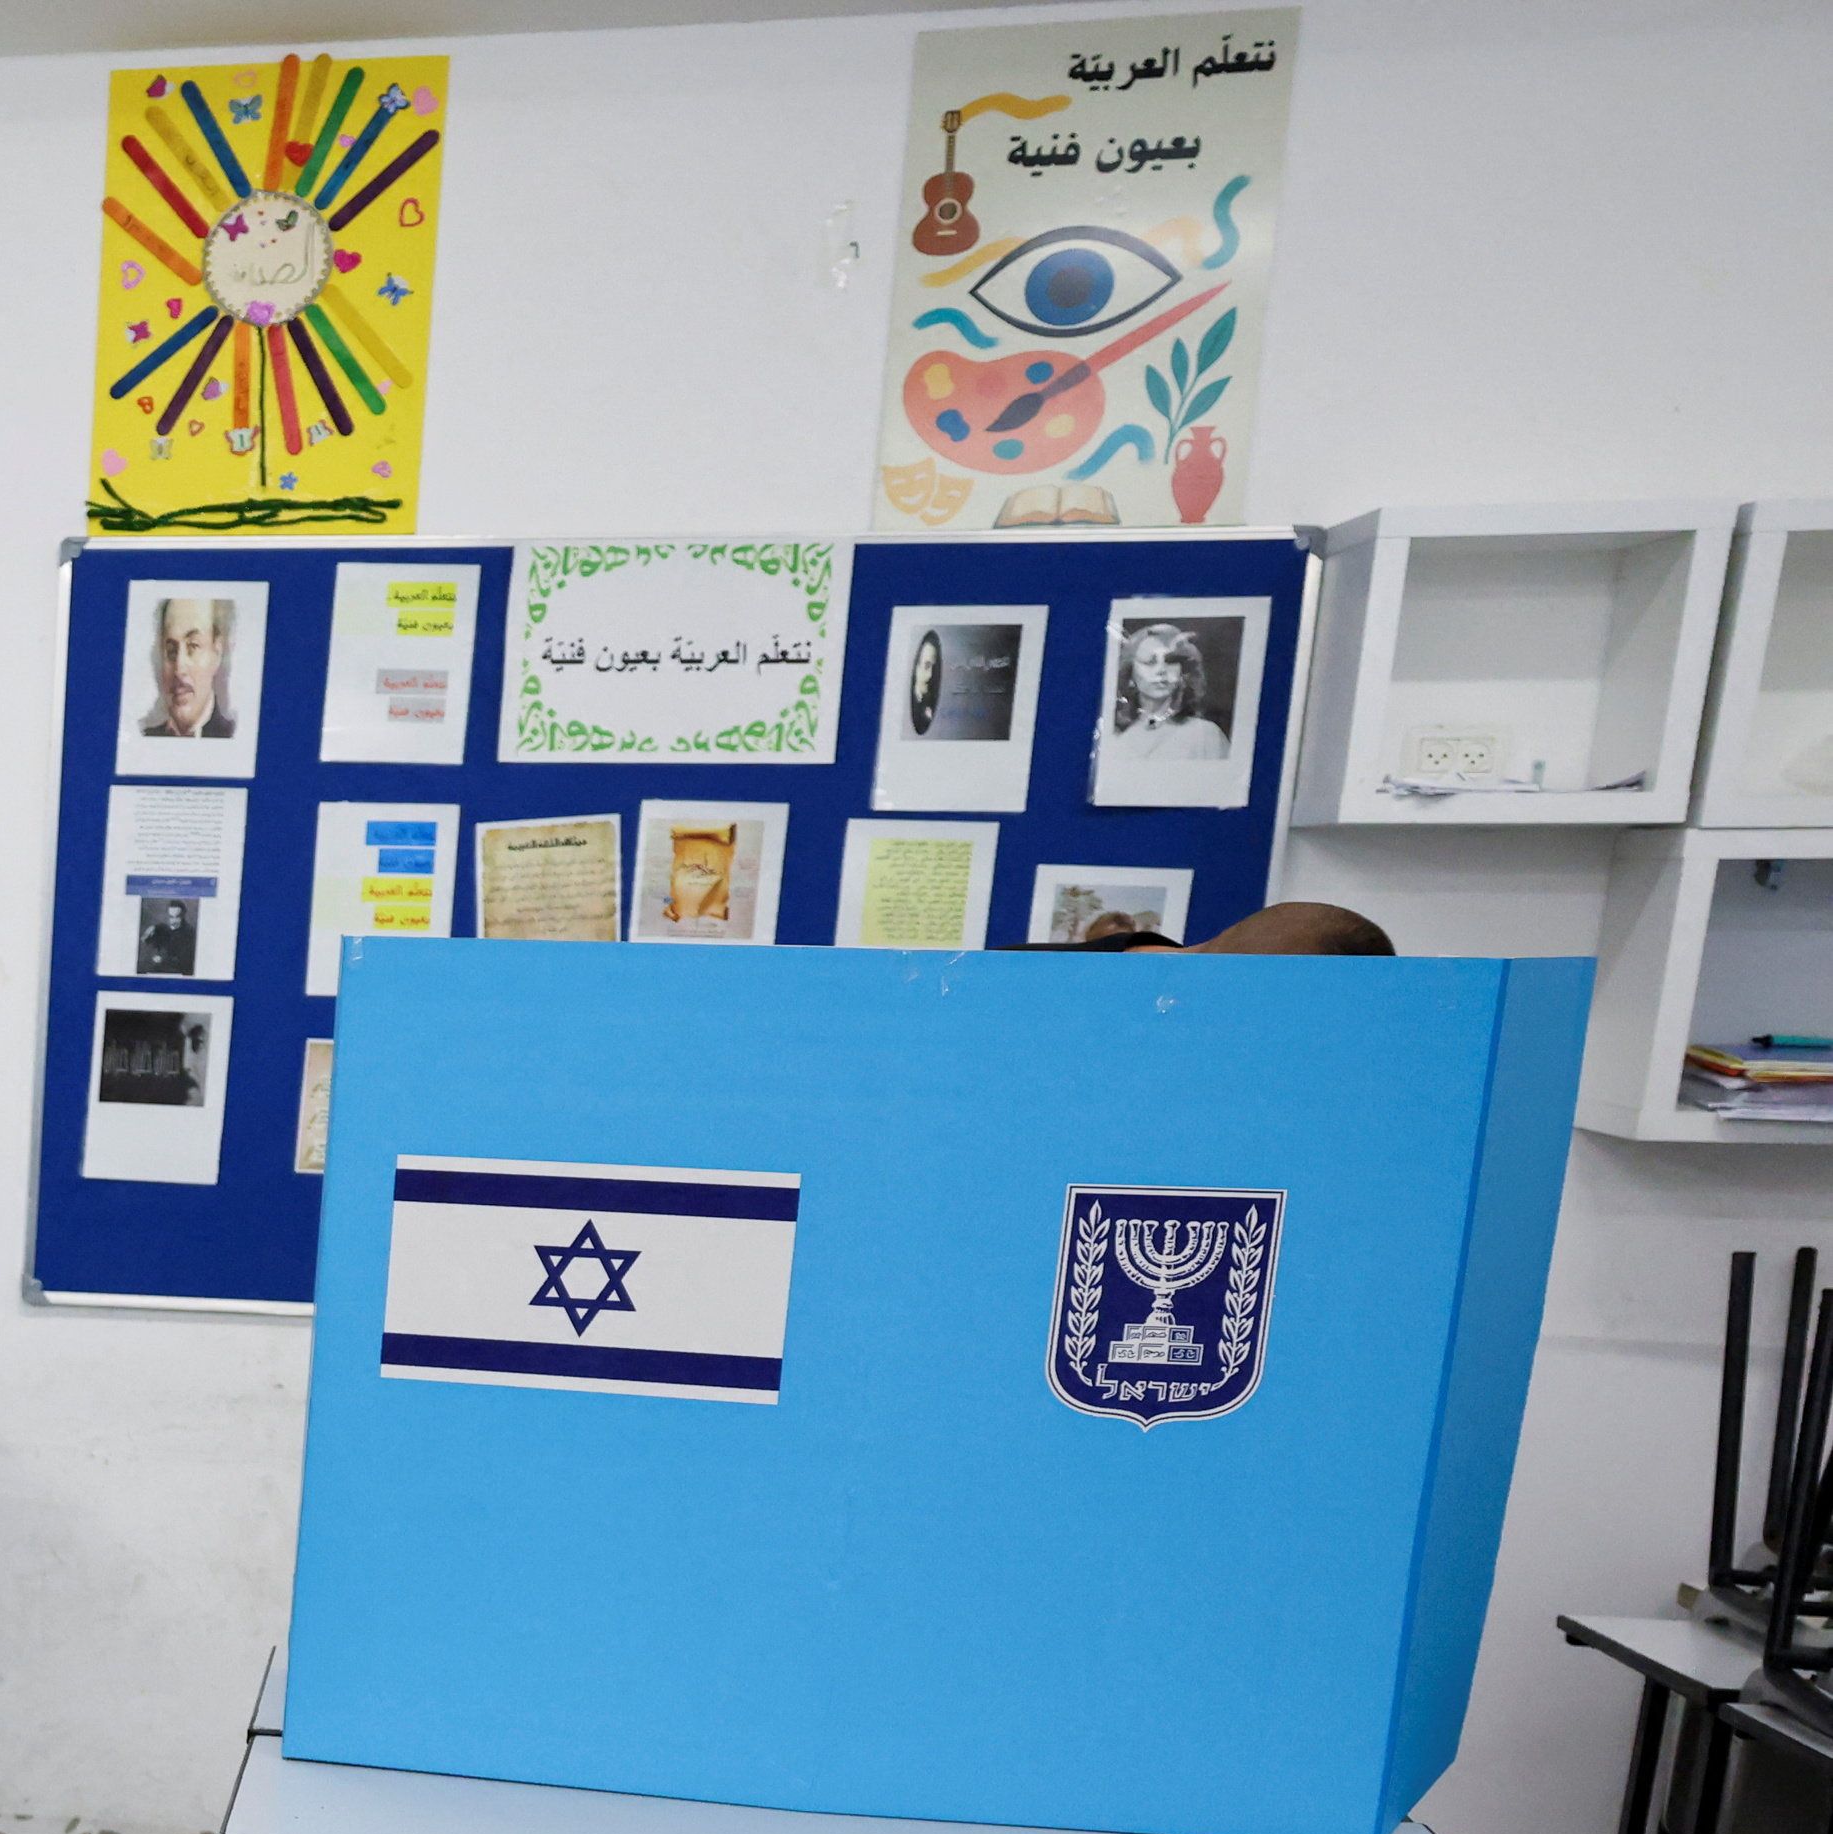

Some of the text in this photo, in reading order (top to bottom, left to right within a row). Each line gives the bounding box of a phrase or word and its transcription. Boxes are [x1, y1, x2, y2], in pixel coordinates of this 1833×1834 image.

[1096, 135, 1201, 173] بعيون
[595, 646, 662, 672] بعيون
[1096, 1364, 1212, 1402] ישראל
